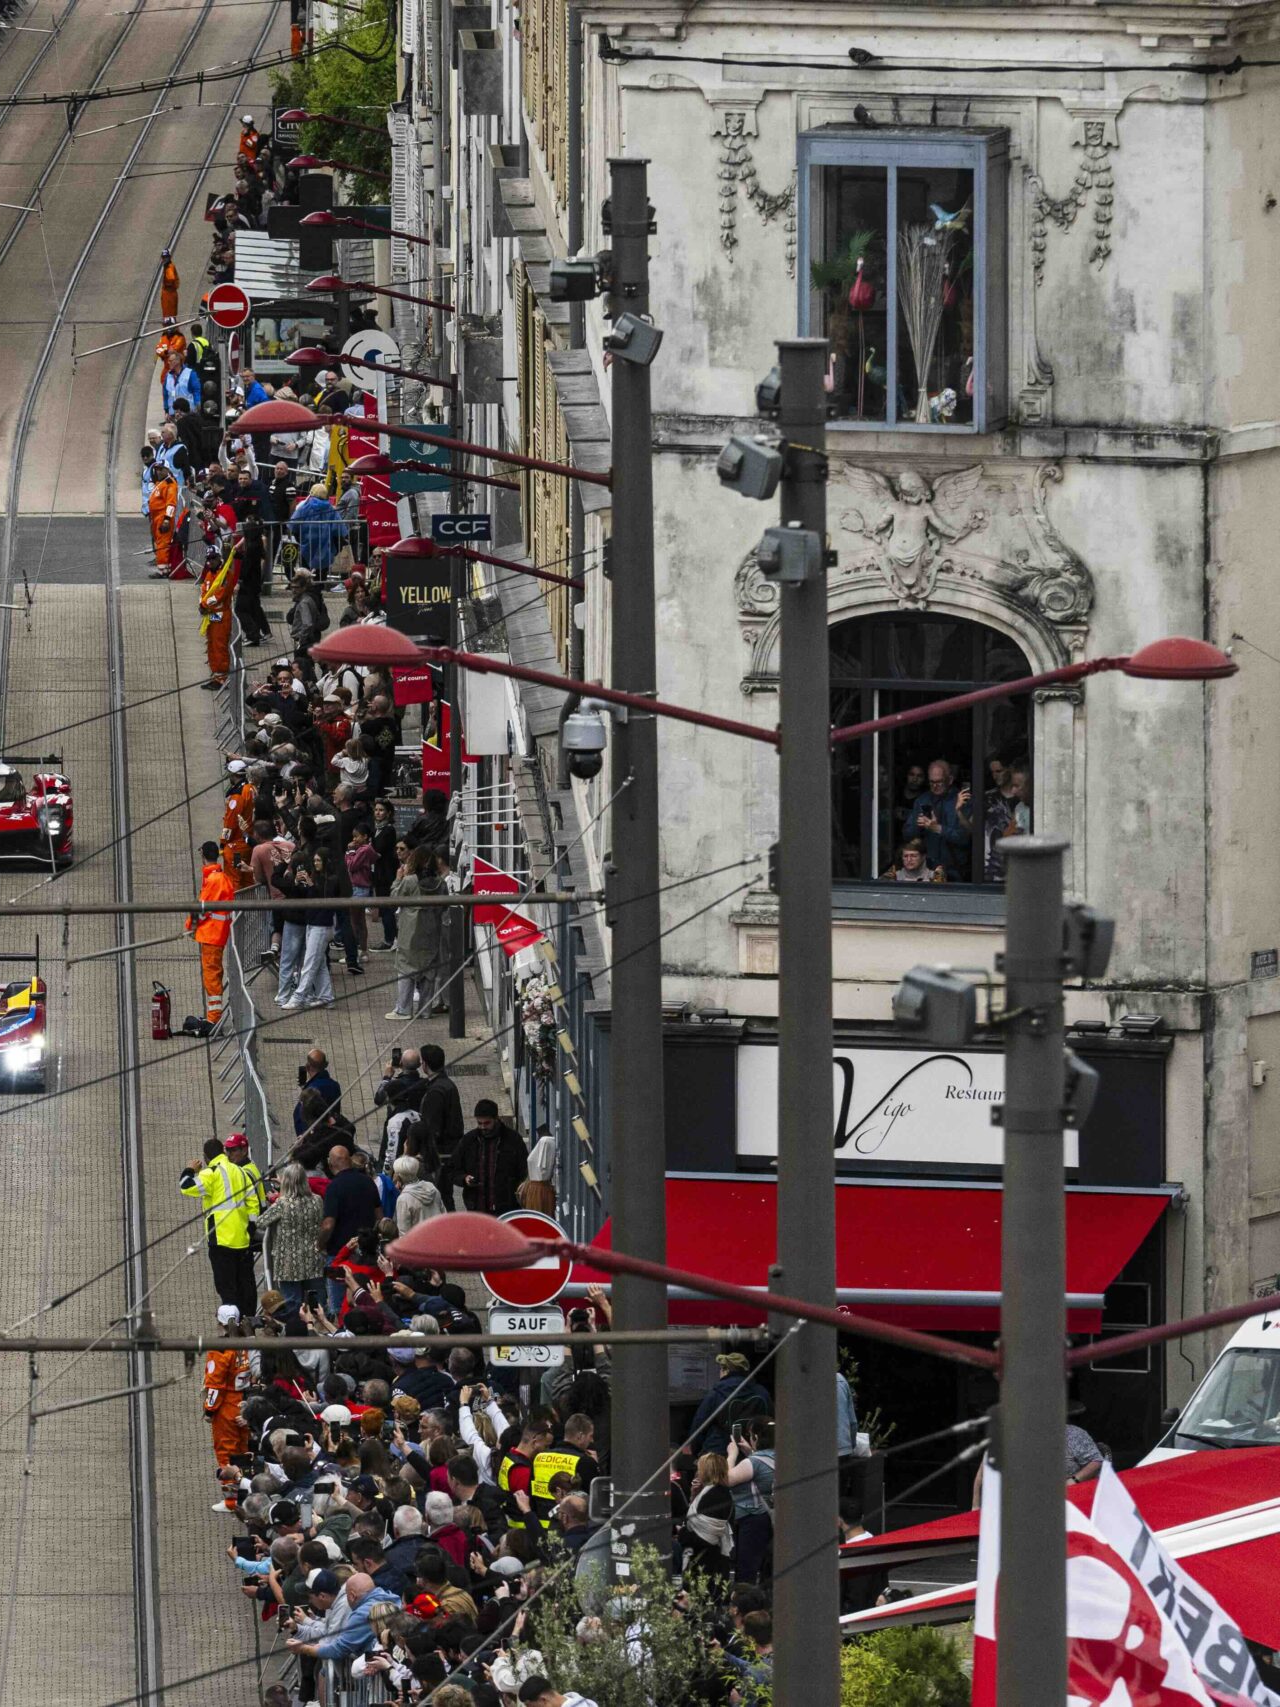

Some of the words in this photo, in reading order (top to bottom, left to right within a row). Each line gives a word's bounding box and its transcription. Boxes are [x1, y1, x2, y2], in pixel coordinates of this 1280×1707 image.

[439, 520, 489, 535] CCF
[400, 586, 451, 604] YELLOW
[508, 1318, 547, 1330] SAUF
[536, 1455, 574, 1465] MEDICAL
